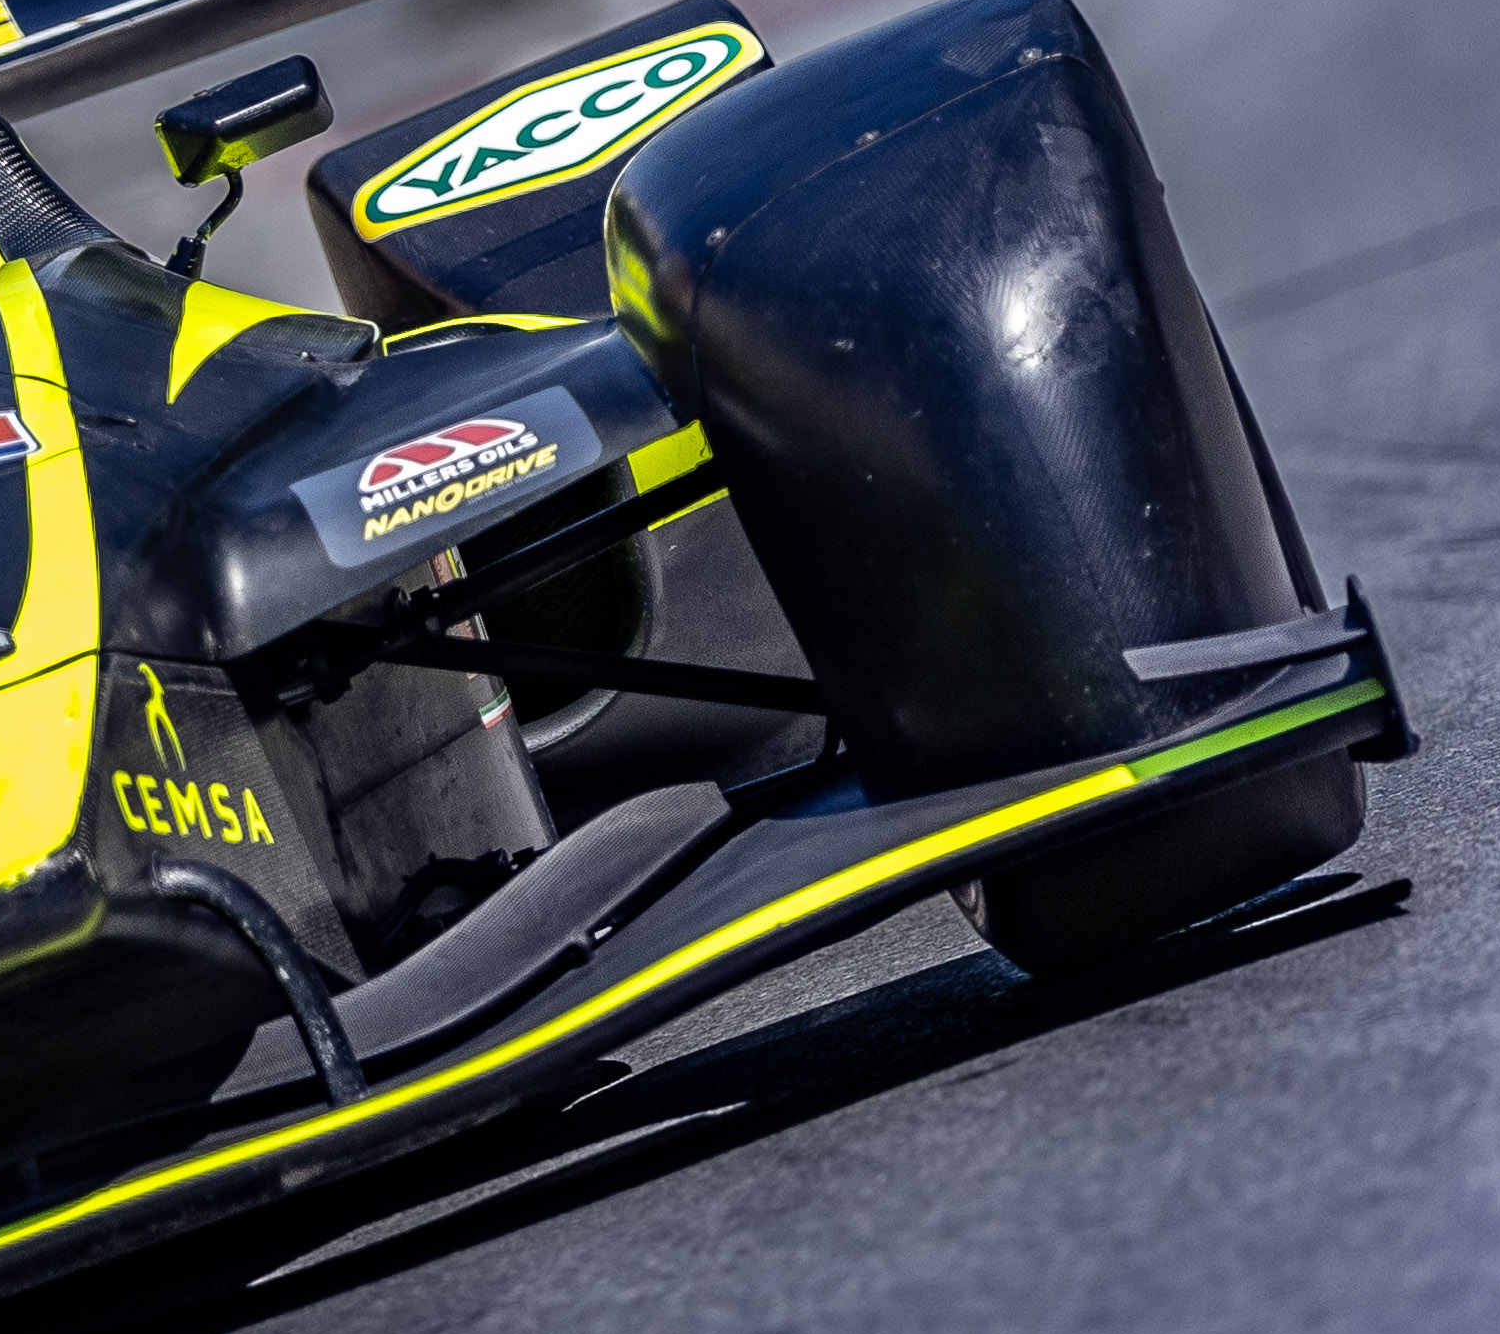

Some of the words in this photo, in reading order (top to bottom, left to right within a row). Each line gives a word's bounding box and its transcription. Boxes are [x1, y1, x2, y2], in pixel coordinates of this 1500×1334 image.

[398, 52, 707, 197] YACCO
[360, 456, 475, 513] MILLERS
[478, 432, 539, 465] OILS
[364, 443, 558, 542] NANODRIVE
[112, 770, 275, 845] CEMSA
